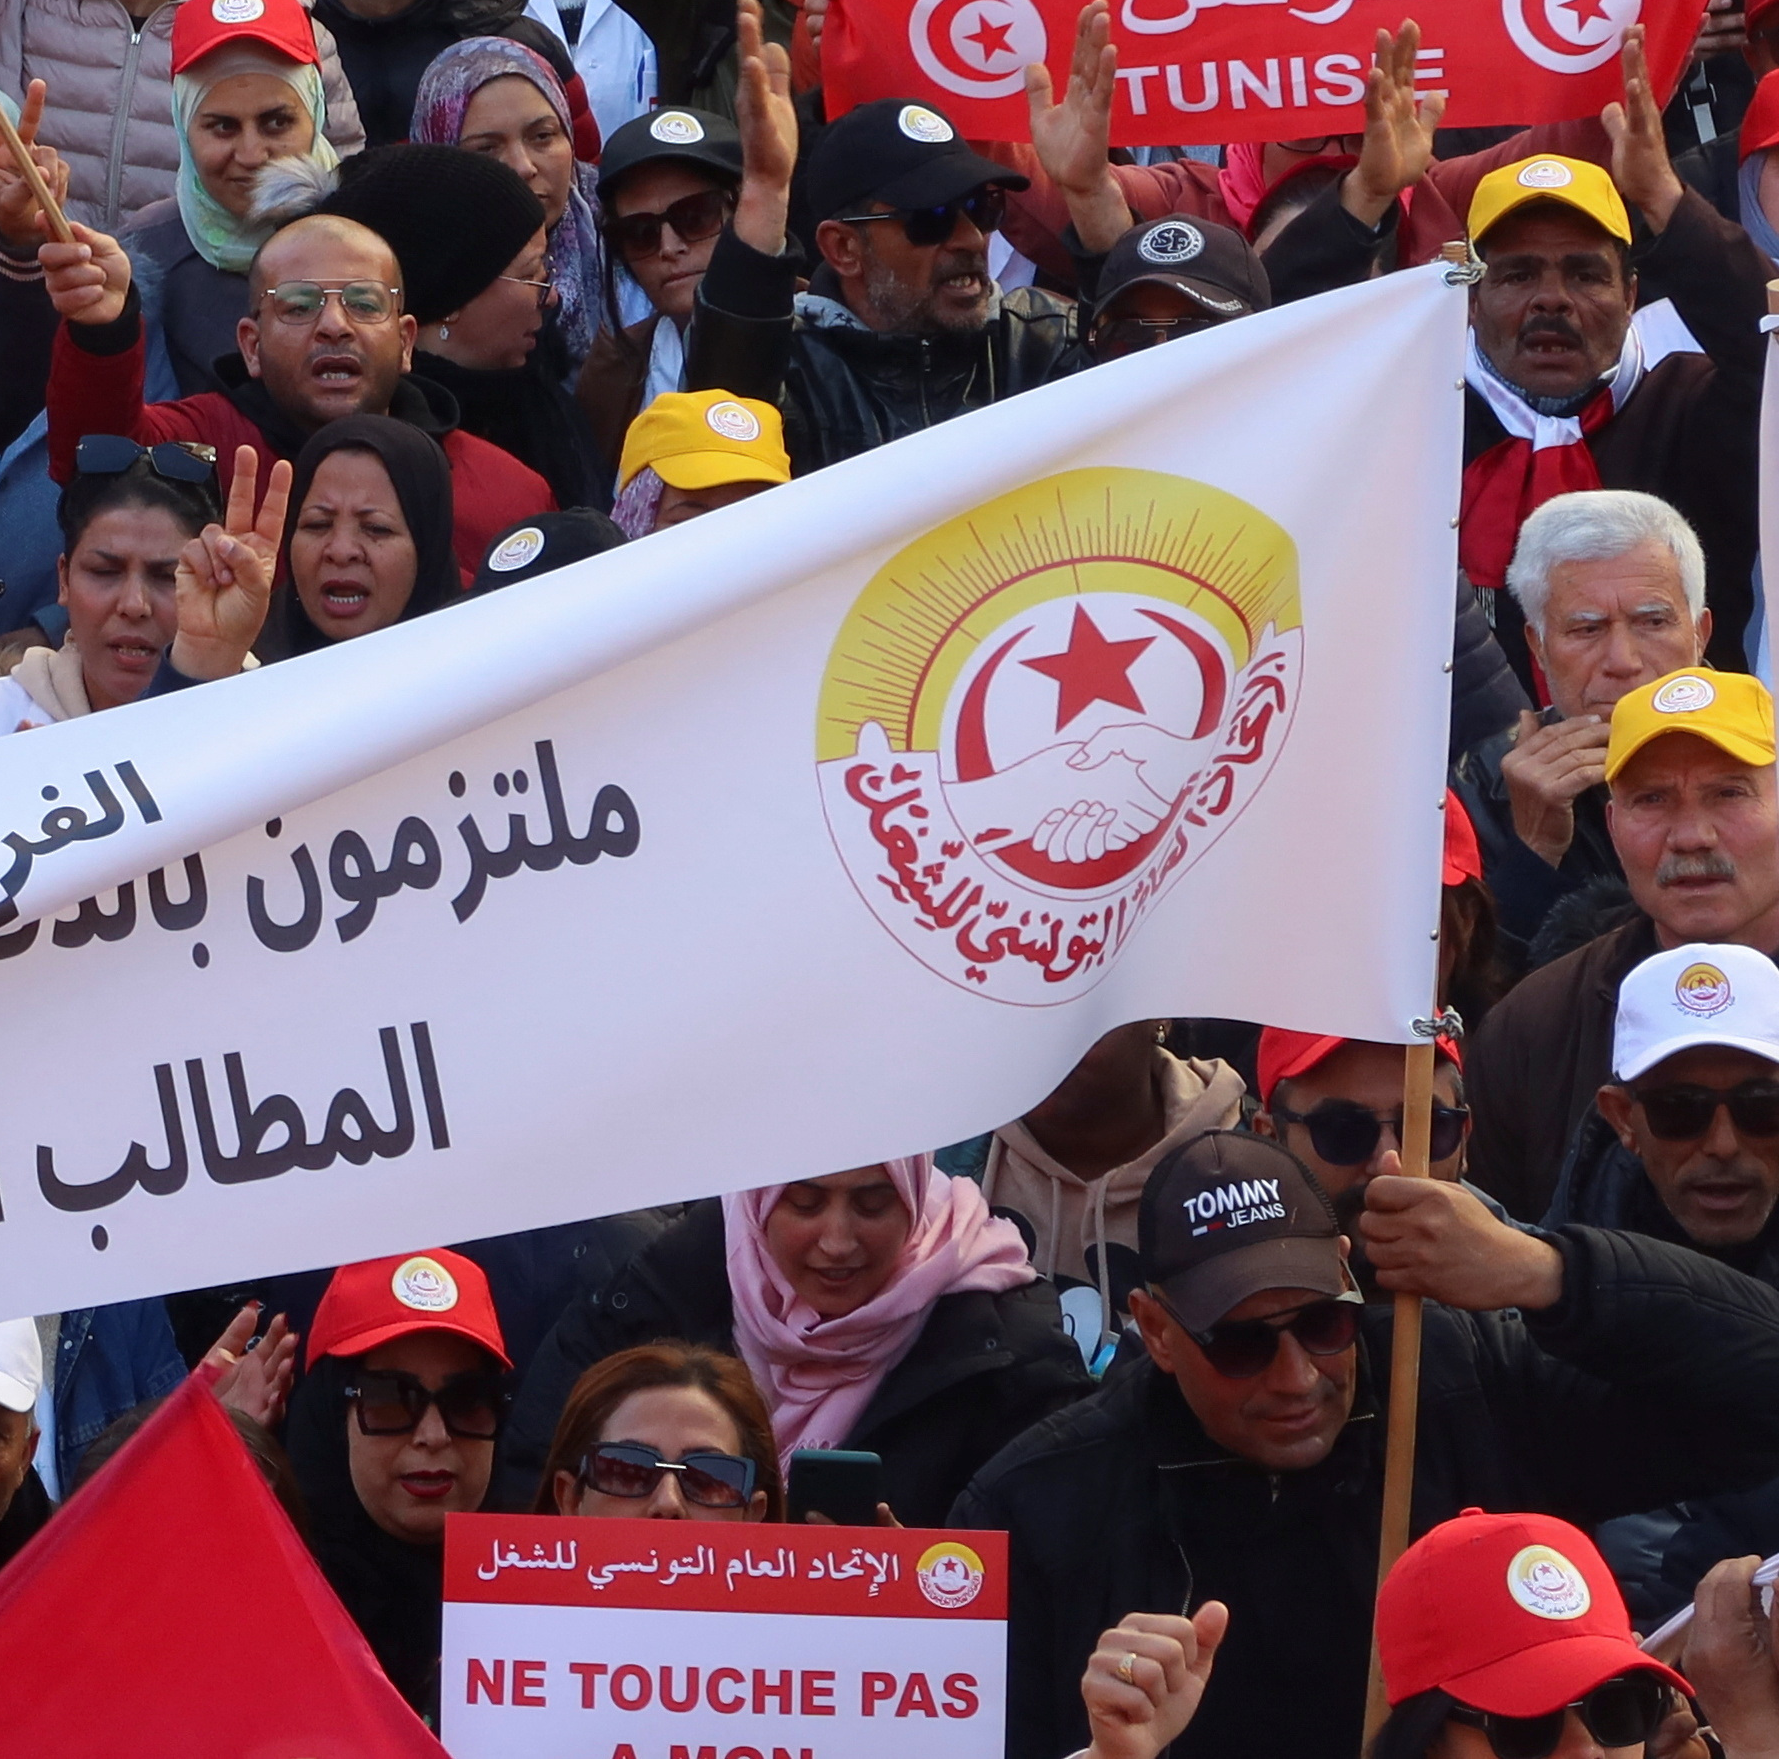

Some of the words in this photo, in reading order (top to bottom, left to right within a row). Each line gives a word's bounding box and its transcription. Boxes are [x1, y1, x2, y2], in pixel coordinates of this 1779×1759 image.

[1114, 47, 1450, 117] TUNISE
[246, 739, 642, 954] ملتزمون
[36, 1020, 451, 1253] المطالب
[1183, 1178, 1280, 1223] TOMMY
[1226, 1202, 1286, 1229] JEANS
[477, 1539, 577, 1581] للشغل
[586, 1544, 715, 1591] التونسي
[725, 1548, 797, 1592] العام
[807, 1548, 901, 1598] الإتحاد
[466, 1657, 548, 1708] NE
[569, 1660, 837, 1717] TOUCHE
[860, 1671, 981, 1720] PAS
